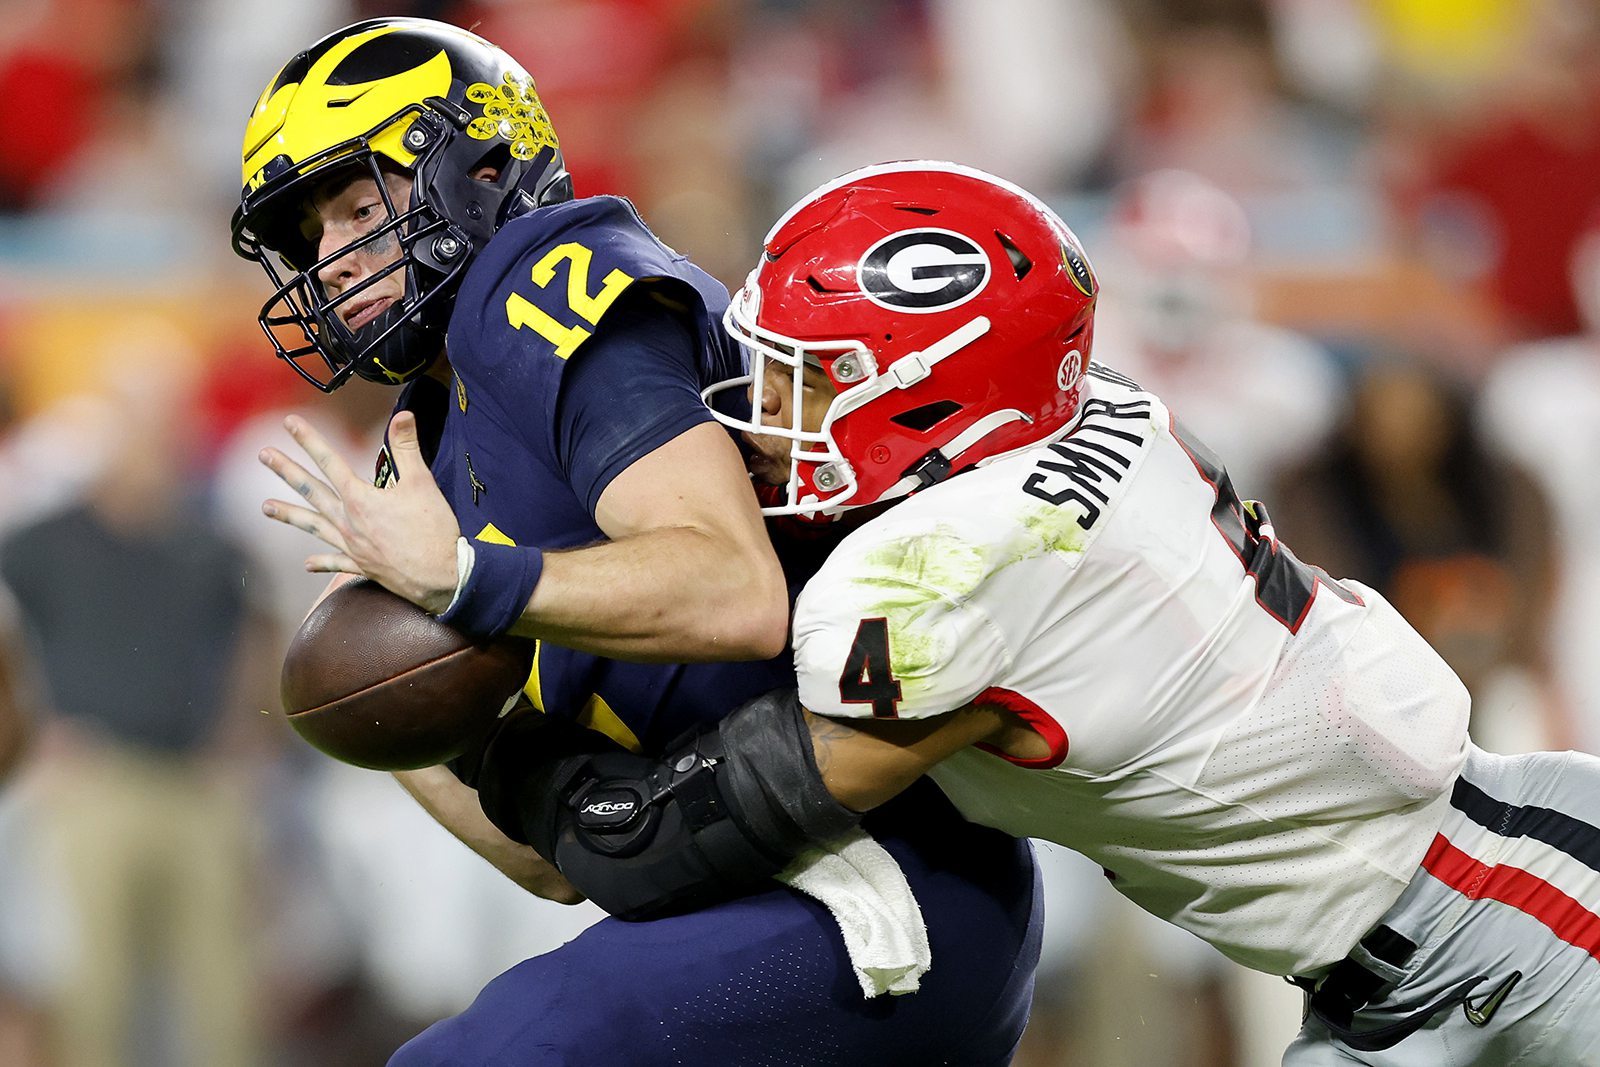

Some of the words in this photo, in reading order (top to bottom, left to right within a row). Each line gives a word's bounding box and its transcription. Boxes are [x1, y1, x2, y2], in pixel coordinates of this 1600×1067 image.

[248, 167, 267, 193] M
[505, 241, 635, 361] 12
[860, 231, 987, 309] G
[1060, 353, 1080, 388] SEC
[1021, 398, 1151, 531] SMITH
[838, 616, 903, 719] 4
